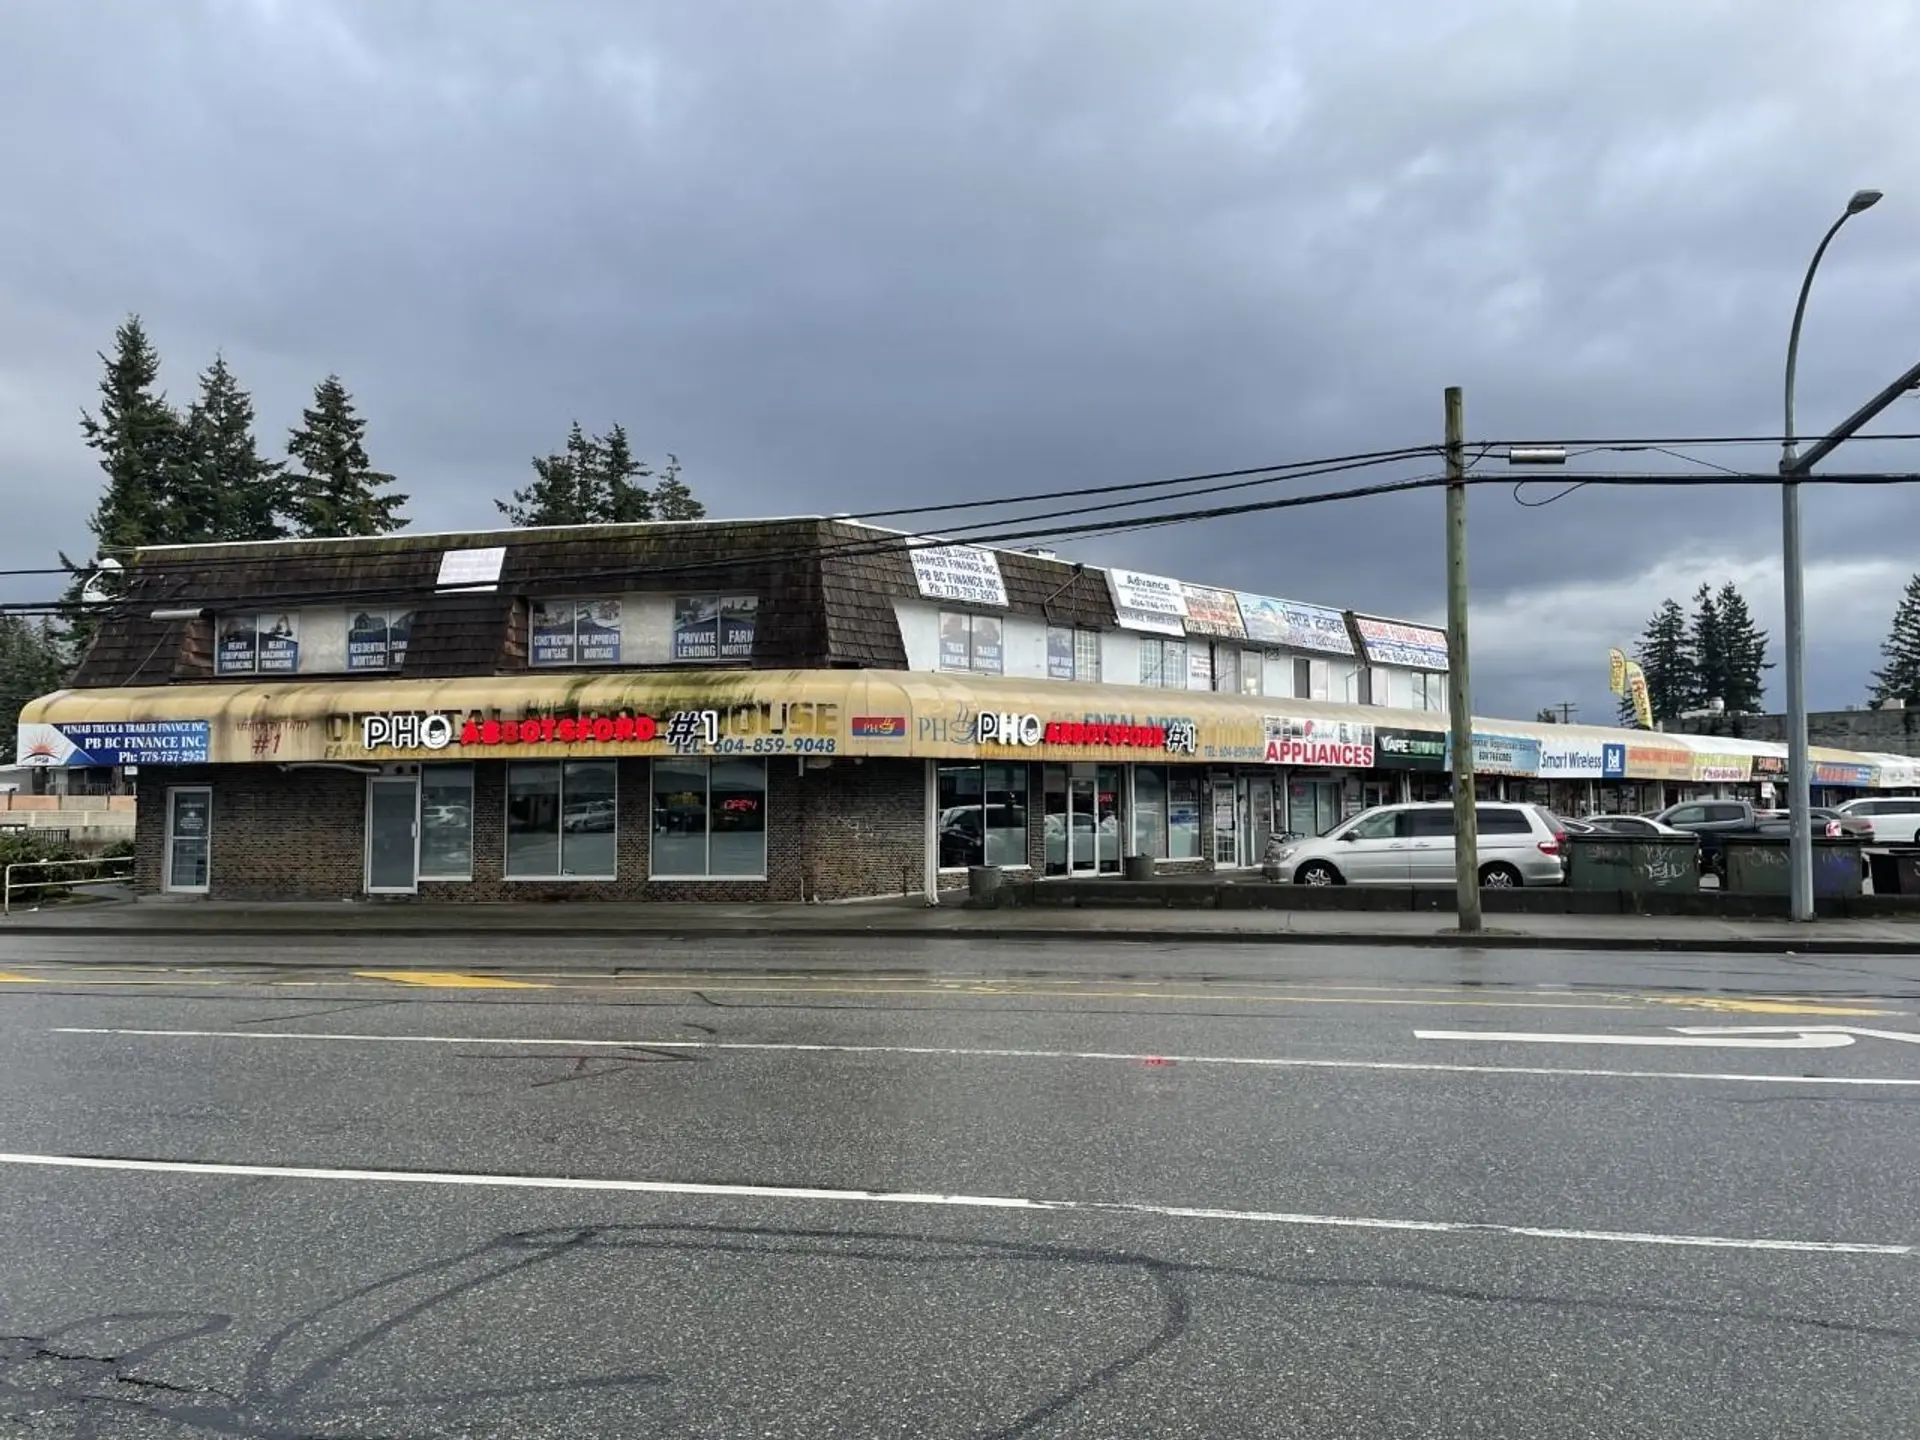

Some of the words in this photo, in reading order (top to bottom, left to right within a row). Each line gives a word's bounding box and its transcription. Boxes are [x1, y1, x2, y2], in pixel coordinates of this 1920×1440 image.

[914, 554, 948, 568] TRAILER
[948, 559, 981, 573] FINANCE
[918, 568, 931, 581] PB
[933, 570, 946, 582] BC
[947, 573, 984, 588] FINANCE
[1127, 575, 1170, 591] Advance
[534, 634, 573, 646] CONSTRUCTION
[678, 631, 716, 644] PRIVATE
[350, 642, 386, 653] RESIDENTIAL
[538, 647, 568, 659] MORTGAGE
[583, 647, 613, 659] MORTGAGE
[677, 645, 716, 658] LENDING
[352, 654, 385, 666] MORTGAGE
[62, 724, 91, 735] PUNJAB
[92, 724, 117, 734] TRUCK
[118, 724, 124, 733] &
[125, 723, 156, 733] TRAILER
[157, 722, 191, 733] FINANCE
[364, 715, 452, 750] PHO
[460, 716, 658, 747] ABBOTSFORD
[666, 709, 719, 745] #1
[977, 710, 1043, 747] PHO
[1044, 722, 1167, 749] ABBOTSFORD
[1166, 722, 1197, 753] #1
[85, 737, 101, 749] PB
[105, 737, 120, 749] BC
[124, 737, 178, 749] FINANCE
[181, 736, 207, 748] INC.
[252, 734, 281, 754] #1
[713, 738, 836, 754] 604-859-9048
[1381, 735, 1410, 753] VAPE
[118, 751, 138, 763] Ph:
[140, 750, 206, 762] 778-757-2953
[1266, 741, 1374, 766] APPLIANCES
[1541, 751, 1567, 770] Smart
[1569, 751, 1602, 769] Wireless
[1608, 749, 1620, 768] Bell
[724, 799, 757, 811] OPEN
